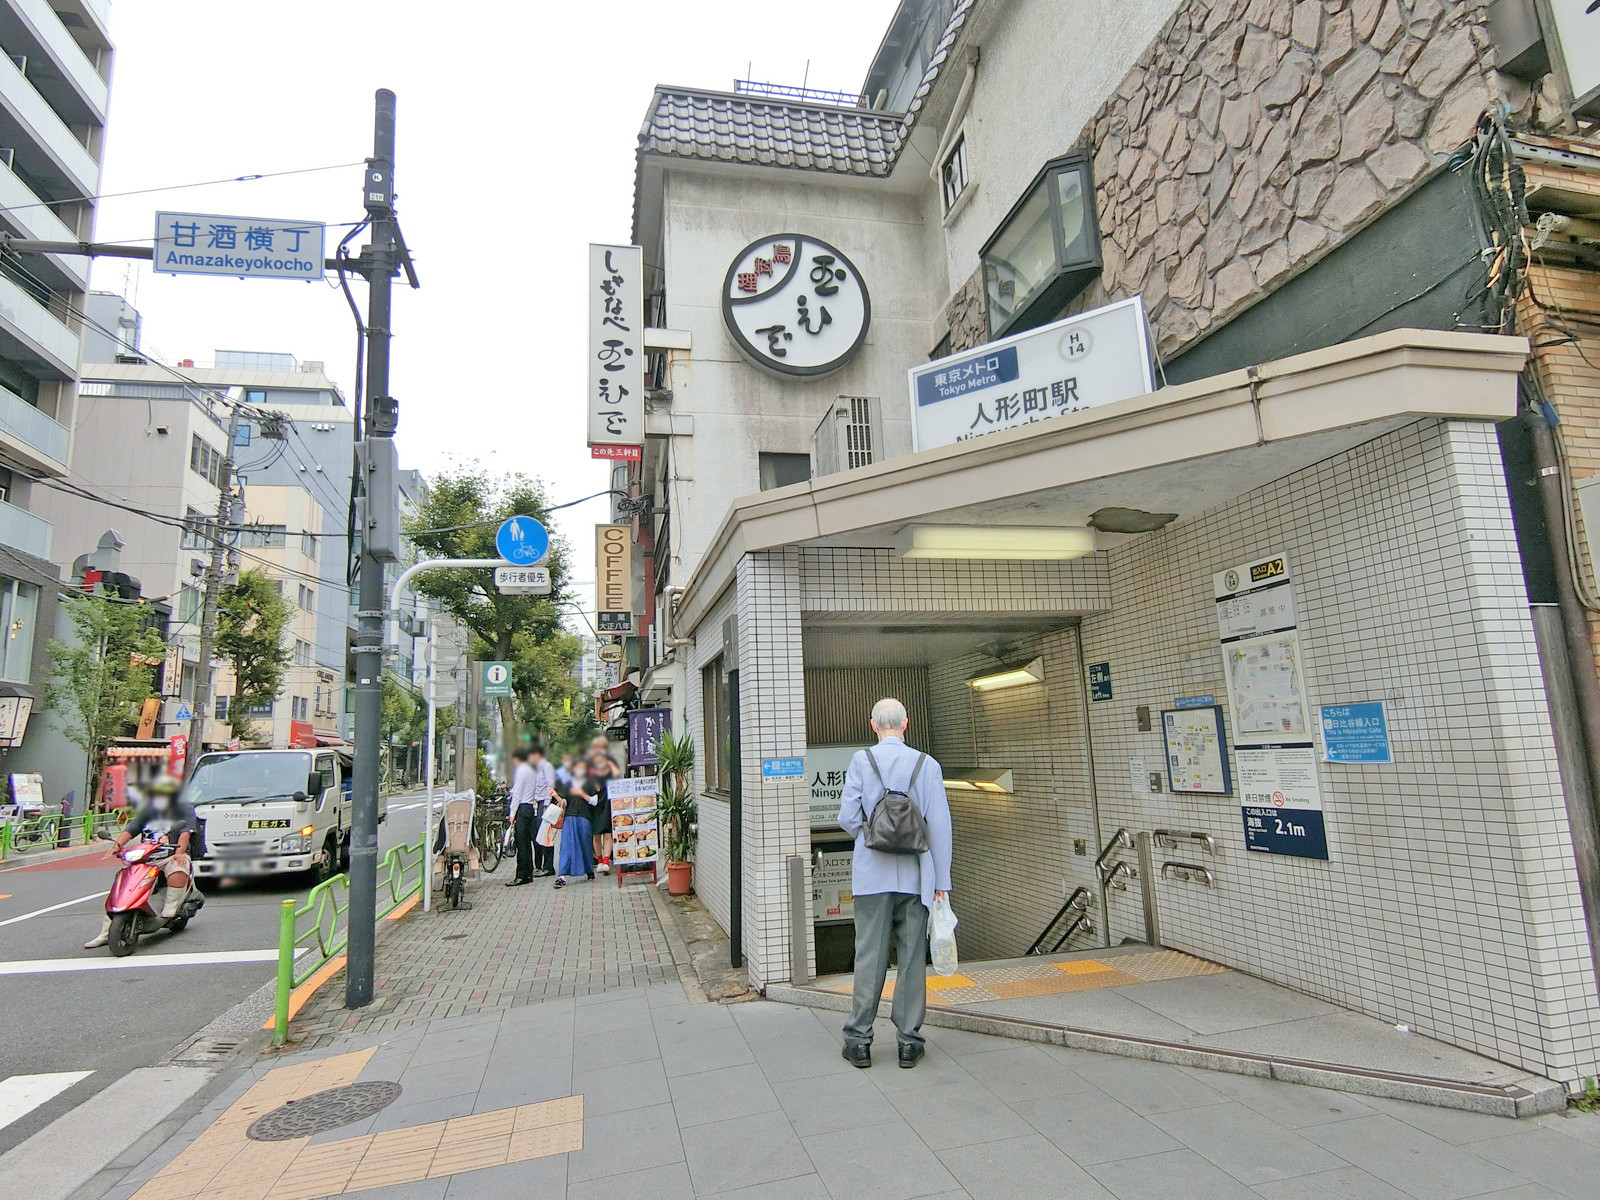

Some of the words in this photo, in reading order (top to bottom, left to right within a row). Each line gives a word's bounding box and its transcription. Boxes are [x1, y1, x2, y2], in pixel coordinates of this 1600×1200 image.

[169, 221, 310, 253] 甘酒横丁
[166, 251, 314, 272] Amazakeyokocho
[1069, 333, 1080, 343] H
[1068, 345, 1085, 356] 14
[934, 357, 999, 387] 東京メトロ
[939, 382, 967, 397] Tokyo
[967, 374, 997, 390] Metro
[969, 377, 1080, 429] 人形町駅
[603, 528, 625, 610] COFFEE
[1267, 560, 1284, 576] A2
[499, 572, 546, 583] 歩行者優先
[599, 622, 630, 630] 大正八年
[1323, 708, 1350, 717] こちらは
[1332, 718, 1379, 729] 日比谷線入口
[812, 770, 846, 787] 人形
[1245, 793, 1272, 803] 終日禁煙
[1246, 808, 1278, 817] この出入口は
[251, 820, 288, 828] 高圧ガス
[1247, 817, 1262, 828] 海抜
[1274, 818, 1305, 837] 2.1m
